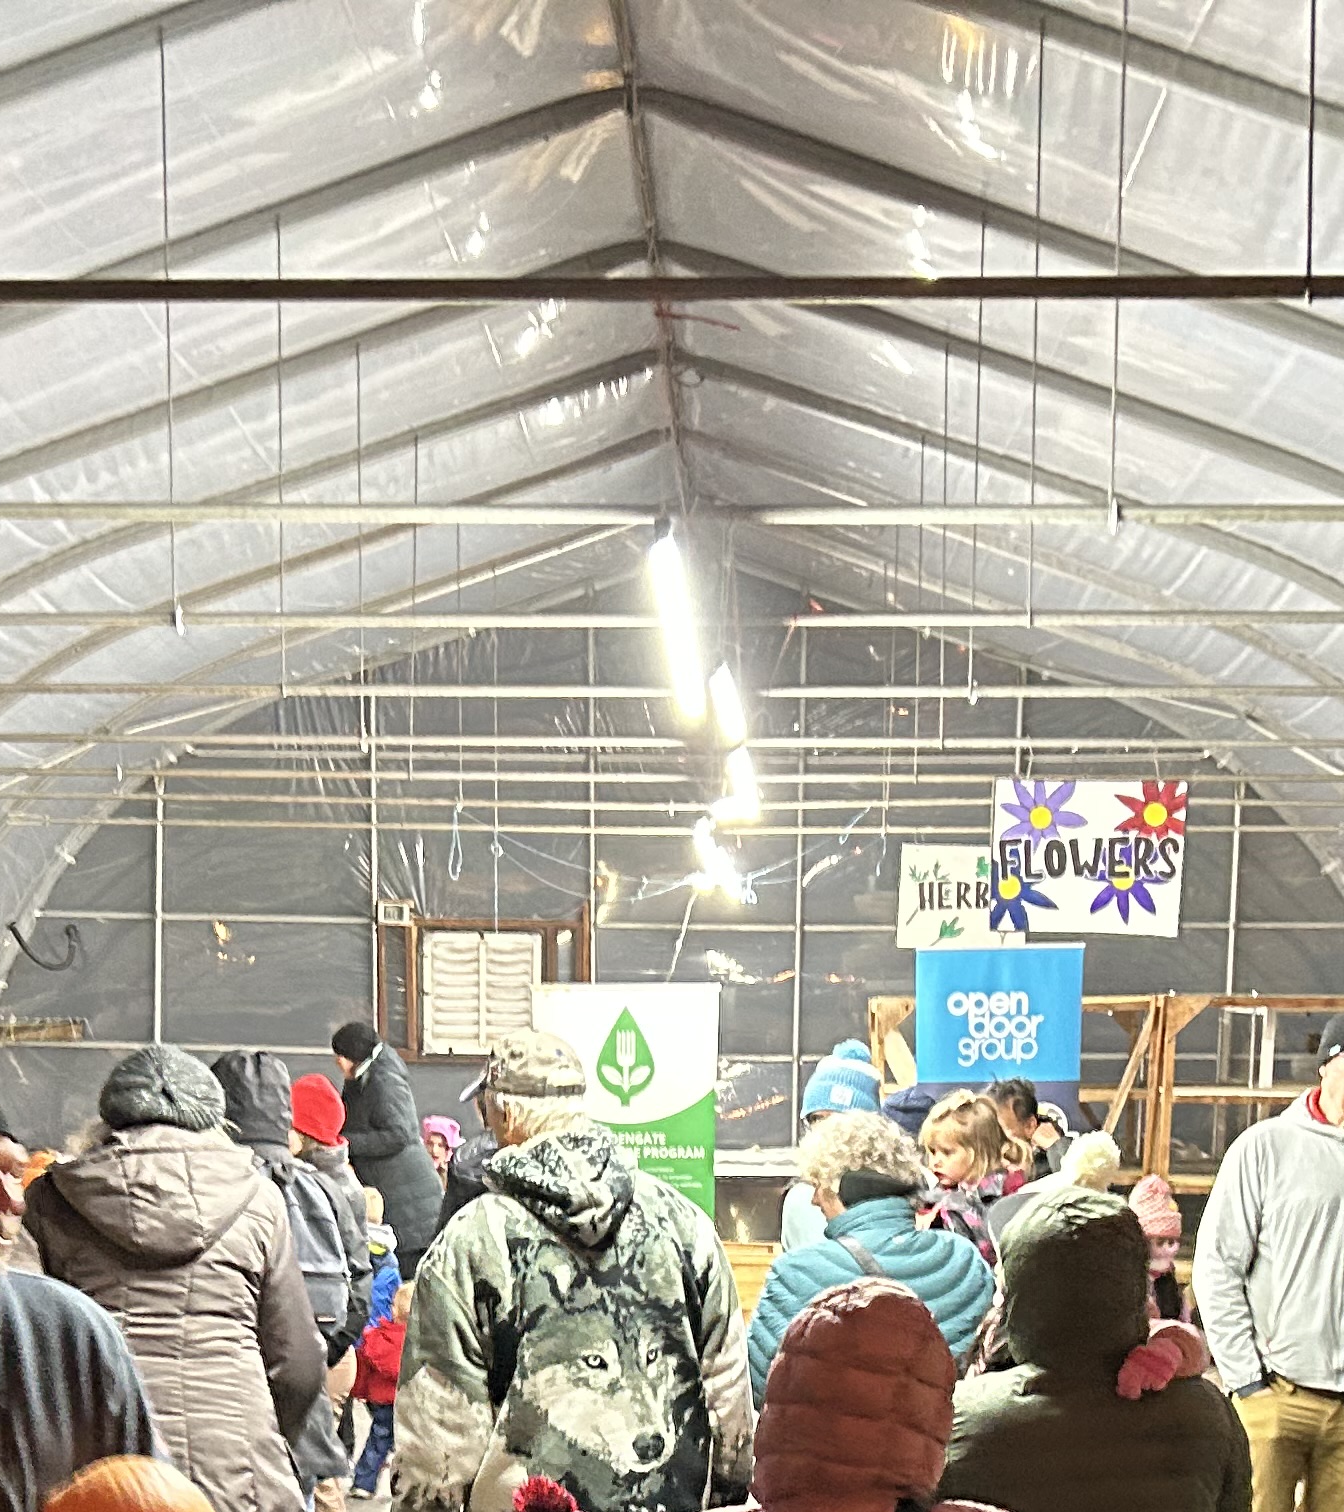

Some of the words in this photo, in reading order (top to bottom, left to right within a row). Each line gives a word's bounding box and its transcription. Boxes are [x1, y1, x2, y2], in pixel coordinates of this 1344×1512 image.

[999, 836, 1180, 880] FLOWERS
[918, 881, 989, 911] HERB
[946, 991, 1029, 1020] open
[967, 1010, 1045, 1039] door
[957, 1037, 1038, 1067] group
[611, 1131, 667, 1146] DENGATE
[642, 1145, 706, 1159] PROGRAM
